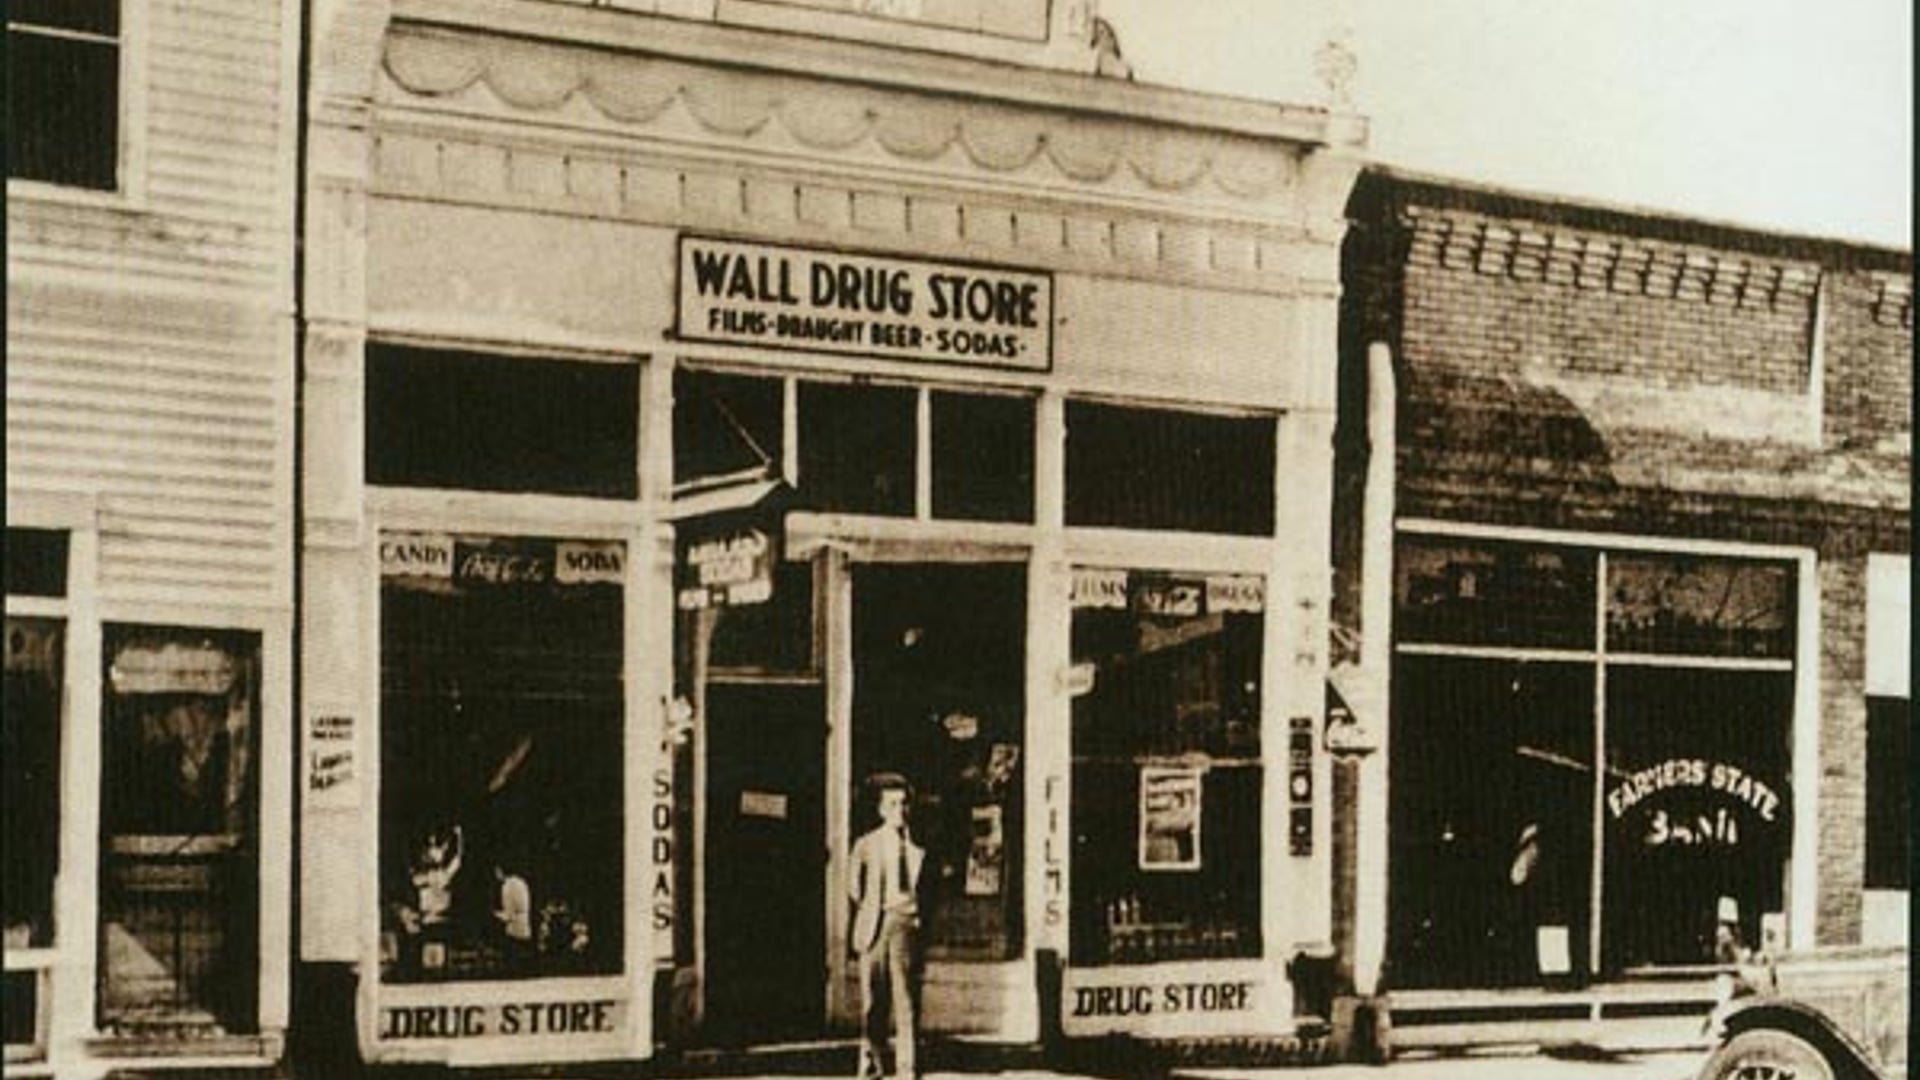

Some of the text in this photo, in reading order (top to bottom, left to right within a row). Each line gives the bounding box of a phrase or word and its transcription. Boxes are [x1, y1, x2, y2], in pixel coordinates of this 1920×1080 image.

[693, 250, 1038, 328] WALL DRUG STORE
[870, 322, 923, 348] BEER
[380, 543, 448, 565] CANDY
[565, 551, 621, 572] SODA
[1608, 759, 1780, 822] FARMERS STATE
[653, 769, 672, 931] SODAS
[1044, 774, 1062, 927] FILMS
[1072, 981, 1254, 1017] DRUG STORE
[379, 1000, 615, 1041] DRUG STORE
